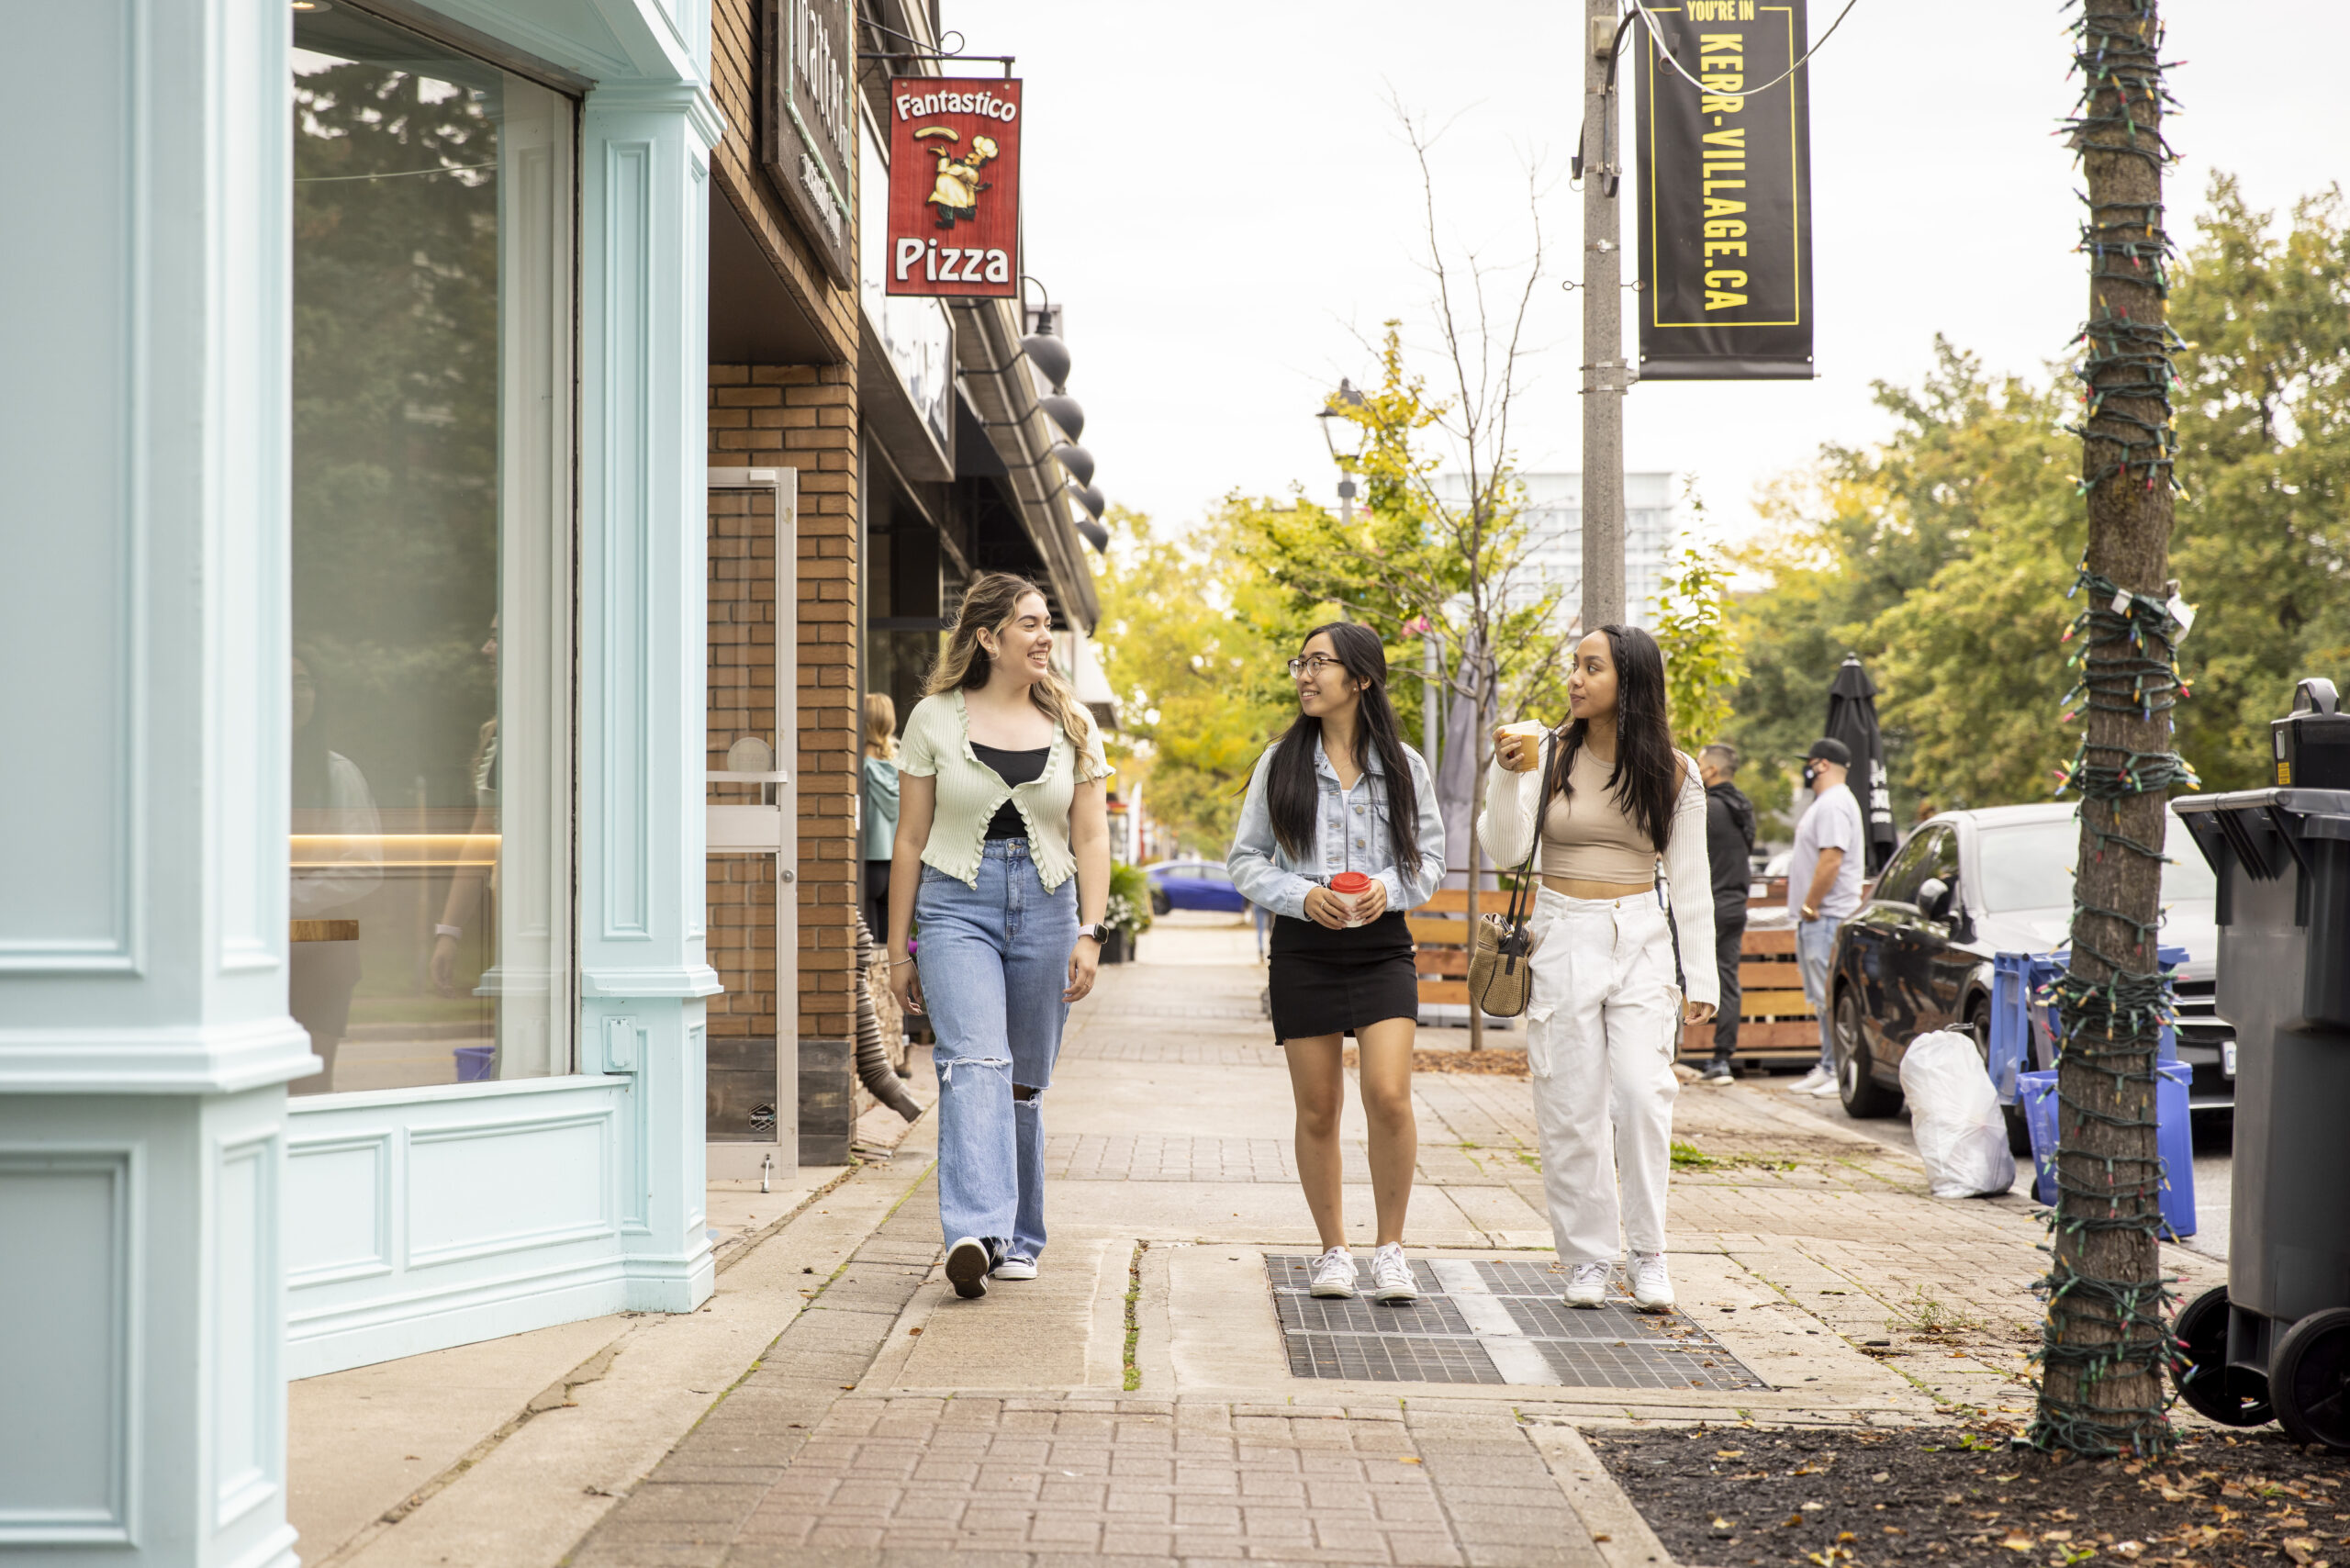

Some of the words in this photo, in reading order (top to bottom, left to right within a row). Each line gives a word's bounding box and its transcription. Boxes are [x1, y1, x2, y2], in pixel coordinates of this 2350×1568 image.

[1686, 0, 1736, 21] YOU'RE
[1739, 0, 1754, 21] IN
[896, 91, 1016, 122] Fantastico
[1700, 34, 1748, 310] KERR-VILLAGE.CA
[896, 238, 1009, 283] Pizza
